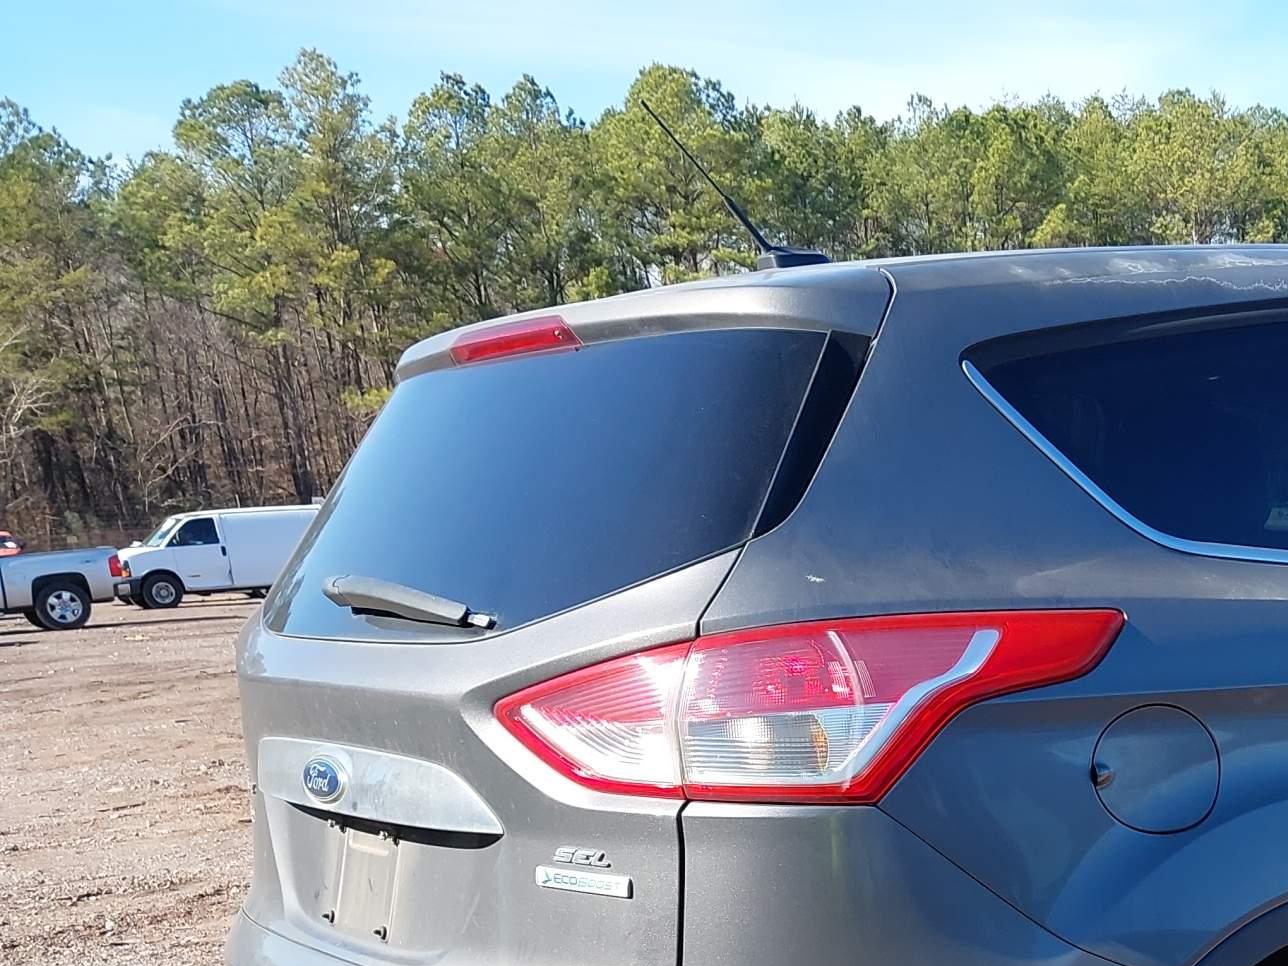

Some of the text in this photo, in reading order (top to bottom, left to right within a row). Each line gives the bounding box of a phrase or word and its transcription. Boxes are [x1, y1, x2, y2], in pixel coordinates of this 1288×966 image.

[307, 763, 329, 791] Ford
[553, 847, 611, 868] SEL
[553, 873, 620, 890] ECOBOOST
